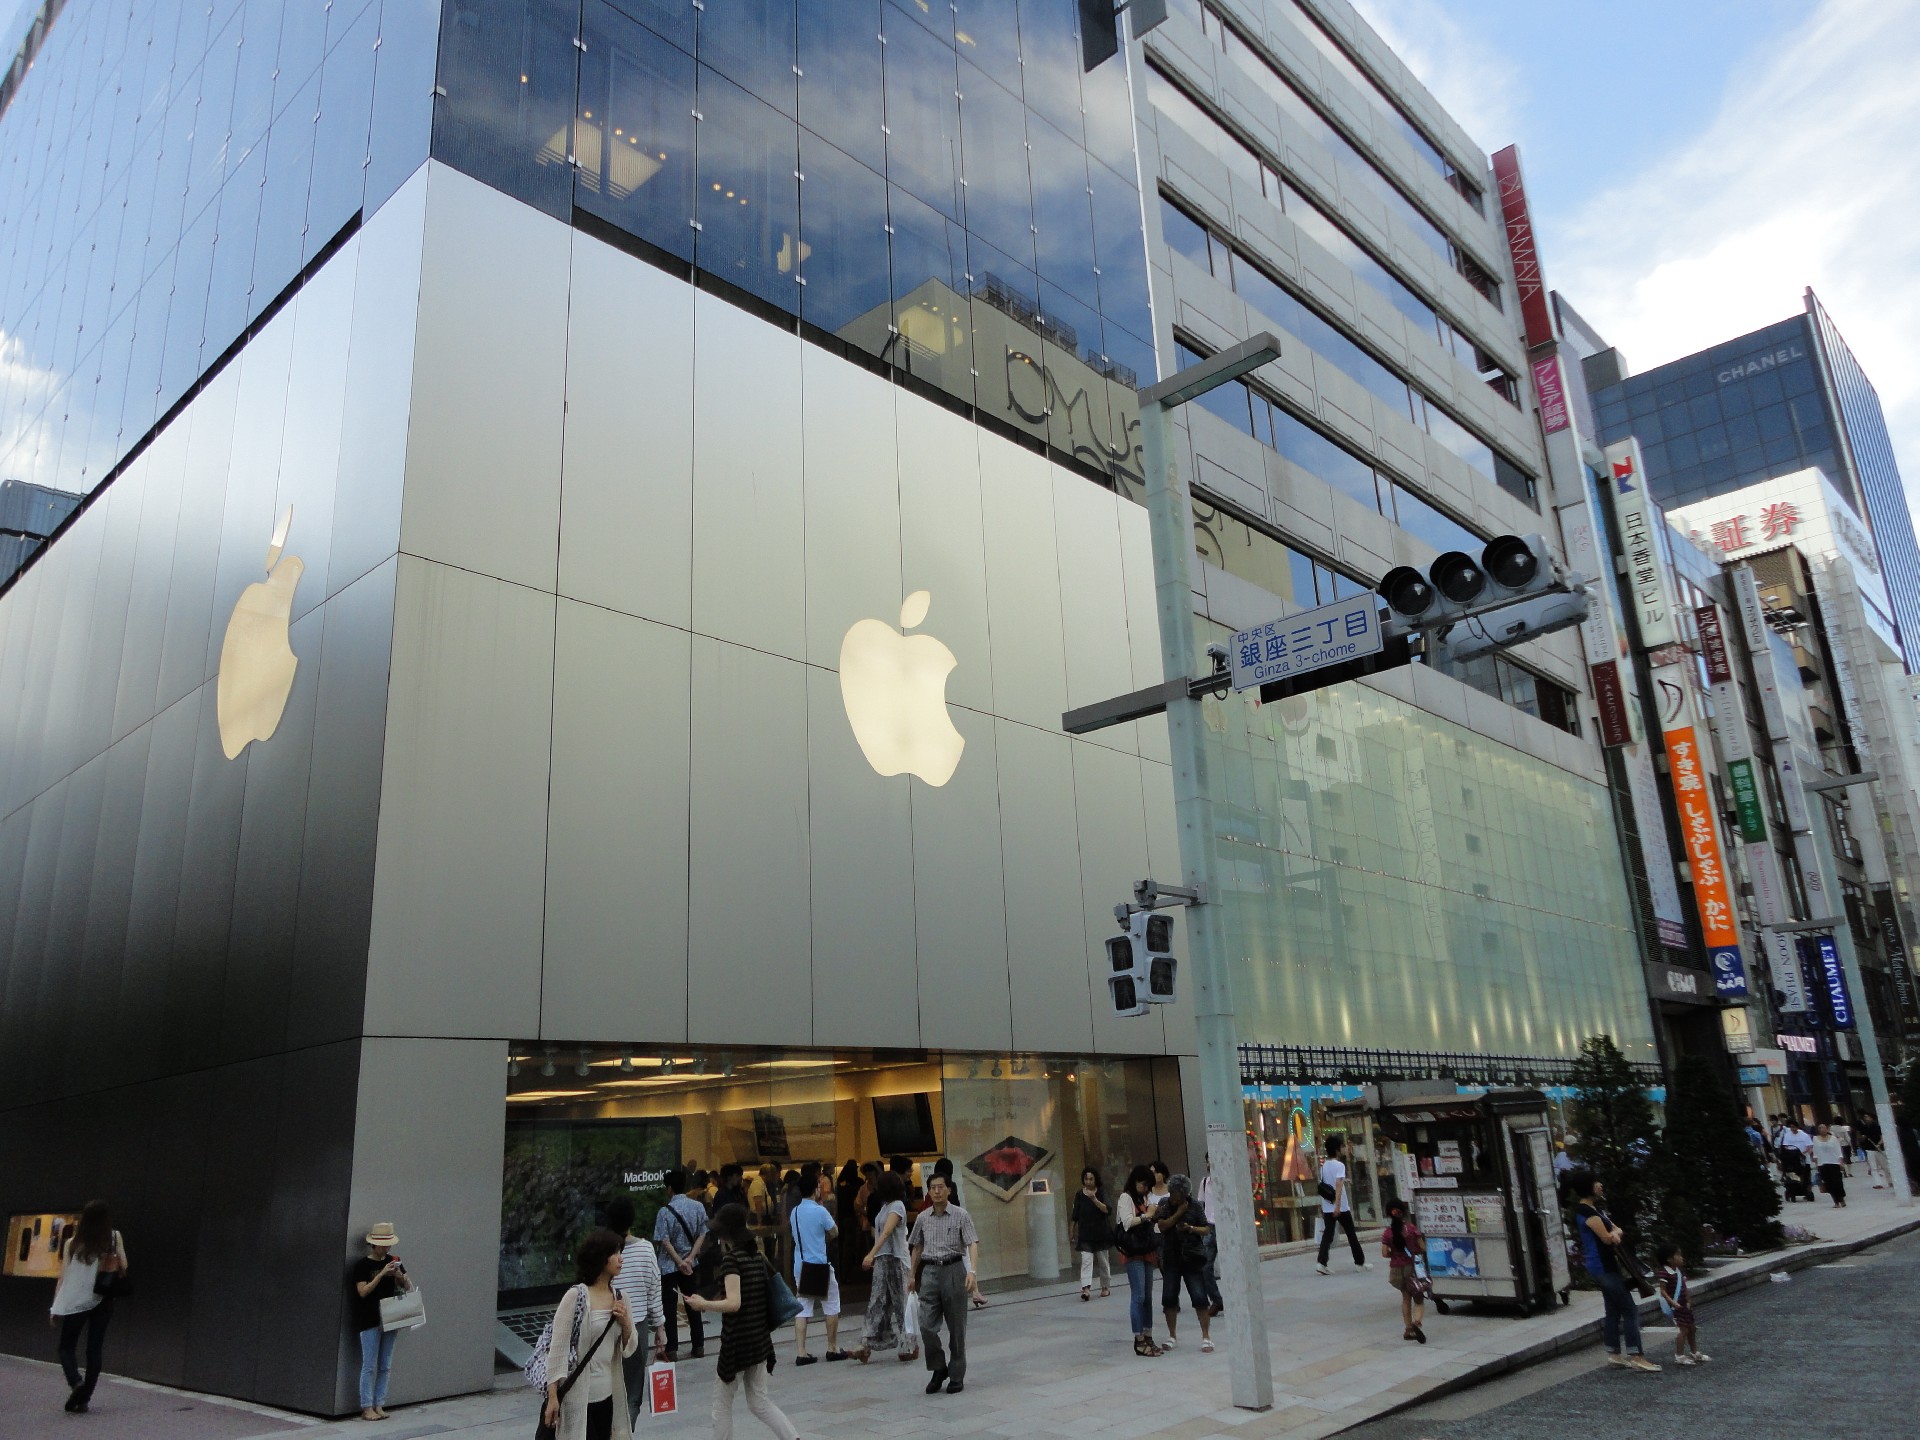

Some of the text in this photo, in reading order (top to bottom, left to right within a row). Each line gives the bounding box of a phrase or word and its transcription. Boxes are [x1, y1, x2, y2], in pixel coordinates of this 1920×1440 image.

[1506, 212, 1542, 302] TAMAYA
[1717, 345, 1803, 384] CHANEL
[1690, 501, 1800, 552] 証券
[1238, 624, 1275, 644] 中央区
[1240, 610, 1368, 668] 銀座三丁目
[1254, 642, 1356, 679] Ginza 3-chome
[1821, 943, 1847, 1023] CHAUMET
[624, 1170, 664, 1183] MacBook
